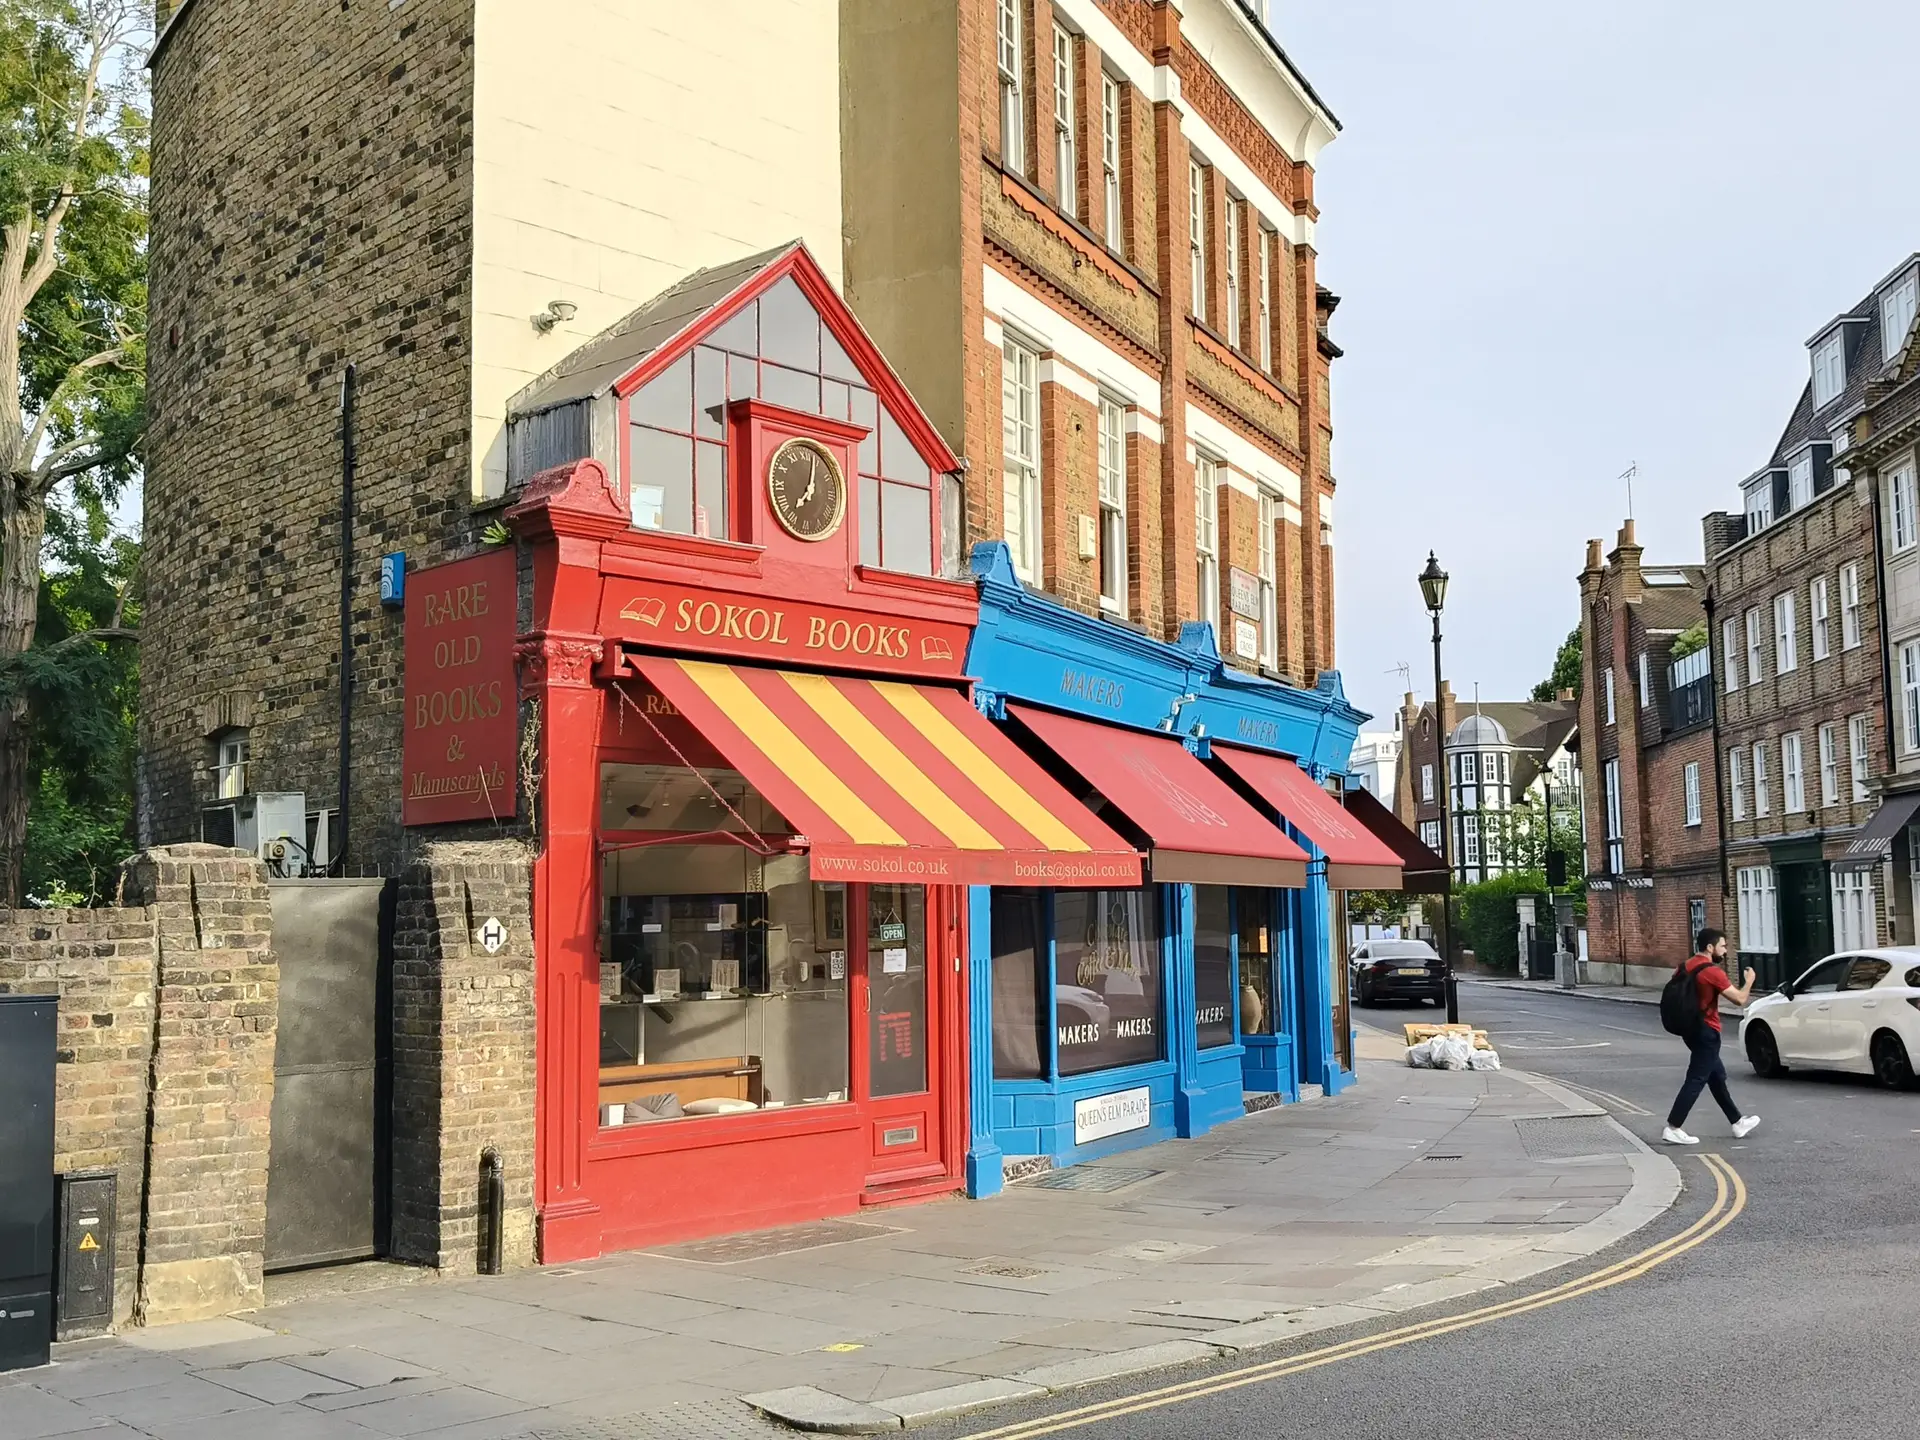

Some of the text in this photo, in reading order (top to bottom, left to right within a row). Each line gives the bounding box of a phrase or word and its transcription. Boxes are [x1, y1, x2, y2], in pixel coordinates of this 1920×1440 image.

[423, 580, 490, 628] RARE
[674, 597, 911, 659] SOKOL BOOKS
[434, 634, 481, 670] OLD
[1060, 667, 1125, 709] MAKERS
[414, 680, 502, 730] BOOKS
[645, 694, 680, 716] RA
[1237, 715, 1279, 745] MAKERS
[446, 734, 465, 762] &
[408, 761, 505, 803] Manuscripts
[818, 855, 1136, 880] www.sokol.co.uk books@sokol.co.uk
[484, 925, 500, 945] H
[883, 928, 903, 940] OPEN
[1058, 1017, 1152, 1046] MAKERS MAKERS
[1108, 1103, 1122, 1121] ELM
[1122, 1097, 1148, 1118] PARADE
